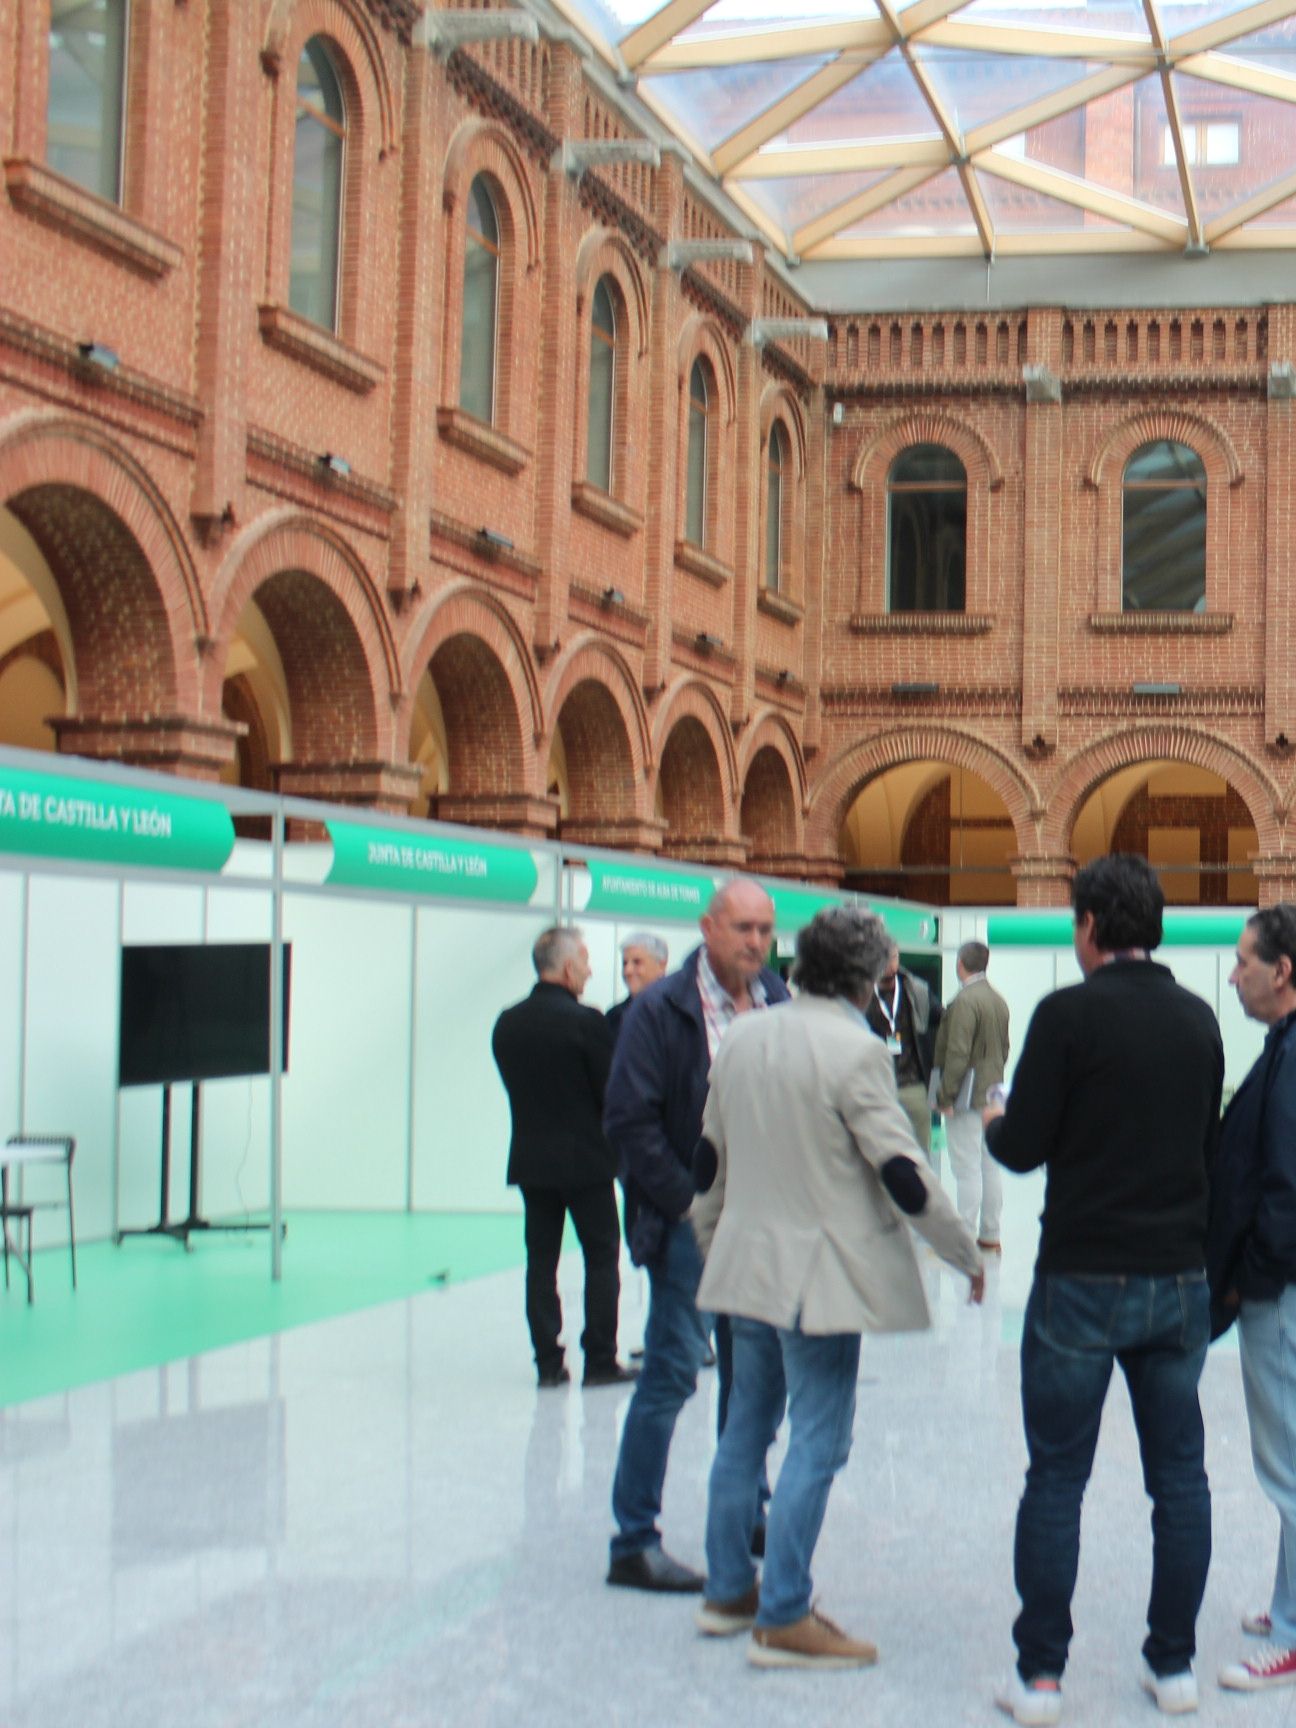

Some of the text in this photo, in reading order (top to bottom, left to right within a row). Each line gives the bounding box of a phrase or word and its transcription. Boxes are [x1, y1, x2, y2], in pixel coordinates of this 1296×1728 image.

[18, 791, 41, 821] DE
[44, 796, 118, 831] CASTILLA
[120, 806, 130, 832] Y
[132, 805, 172, 838] LEÓN
[401, 846, 413, 868] DE
[415, 848, 456, 874] CASTILLA
